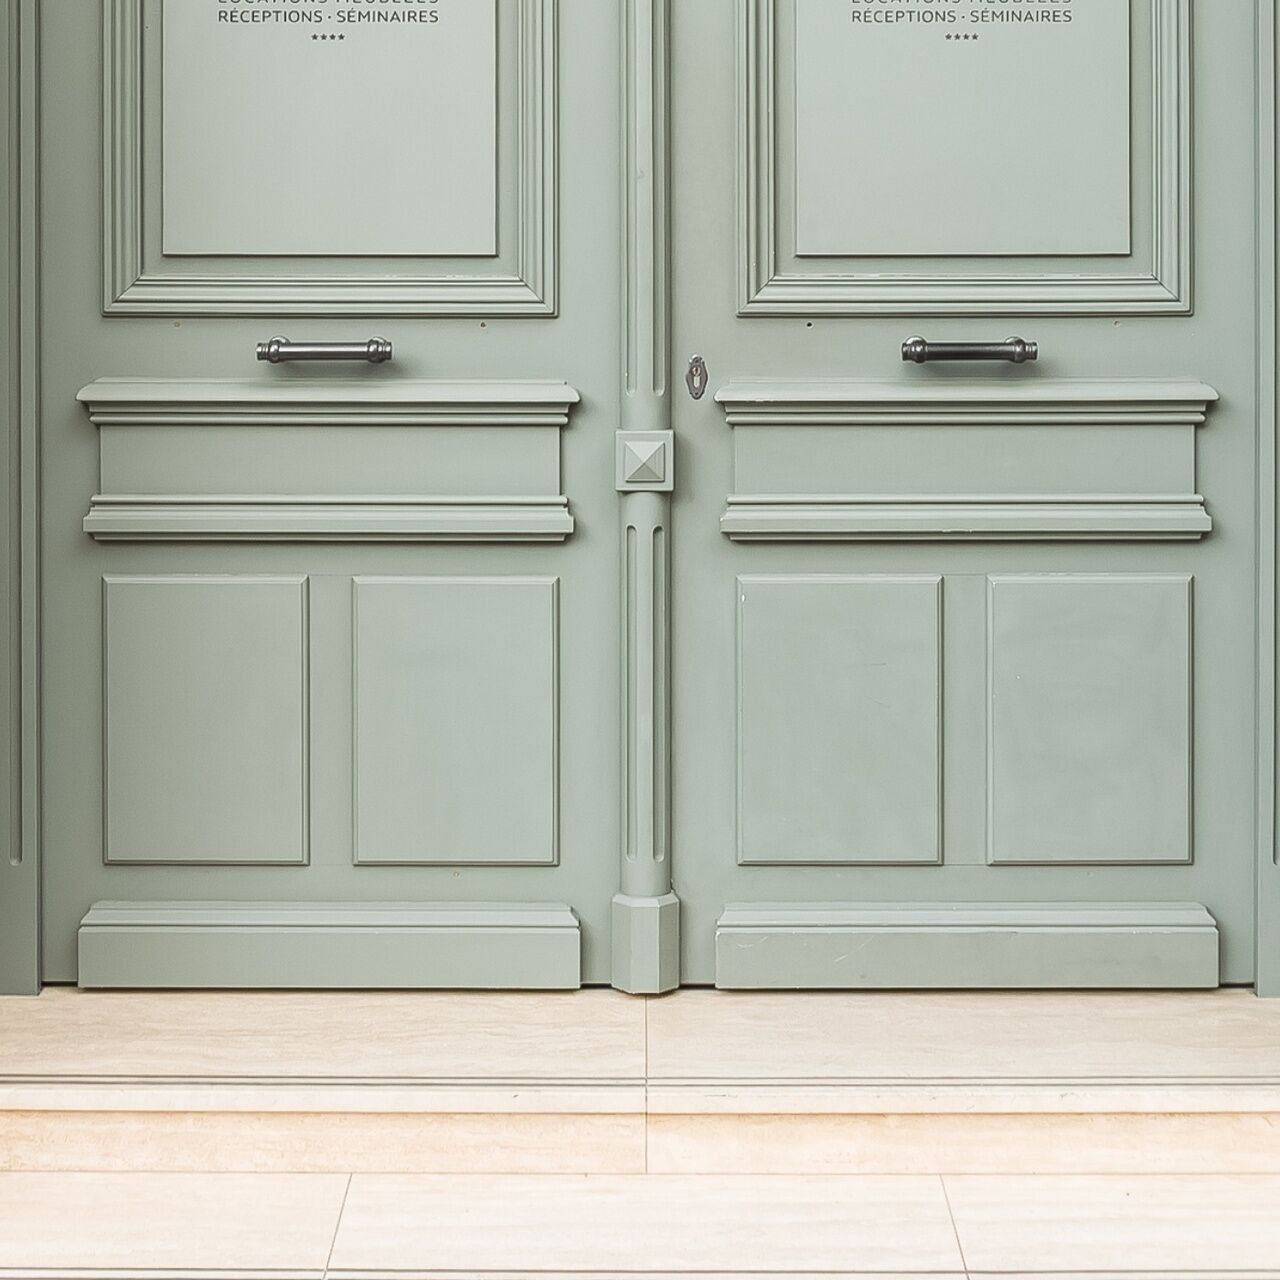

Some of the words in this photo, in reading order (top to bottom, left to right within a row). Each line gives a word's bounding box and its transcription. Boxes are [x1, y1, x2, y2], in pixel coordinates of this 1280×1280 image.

[218, 7, 323, 24] RÉCEPTIONS
[336, 7, 439, 24] SÉMINAIRES
[851, 7, 957, 24] RÉCEPTIONS
[970, 7, 1072, 24] SÉMINAIRES
